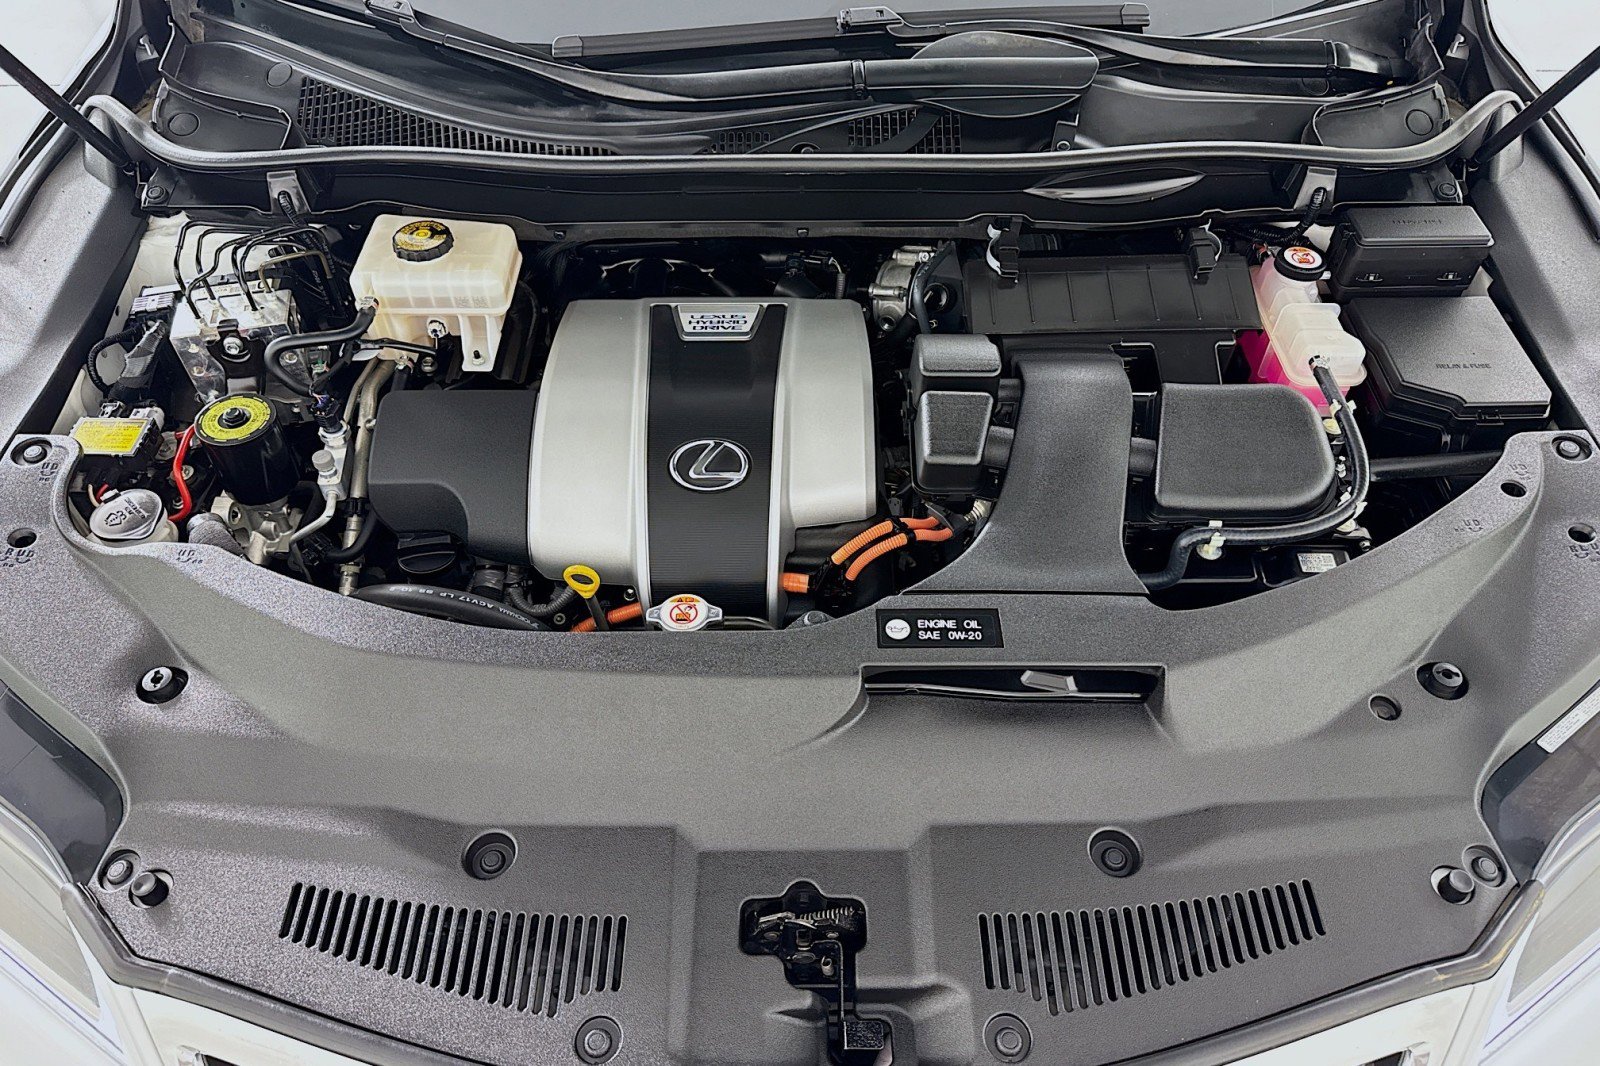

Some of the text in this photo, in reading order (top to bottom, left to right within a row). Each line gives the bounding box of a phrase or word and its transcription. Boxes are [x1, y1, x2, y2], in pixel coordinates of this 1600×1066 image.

[440, 591, 455, 599] LP
[917, 619, 982, 629] ENGINE OIL
[918, 631, 982, 641] SAE 0W-20
